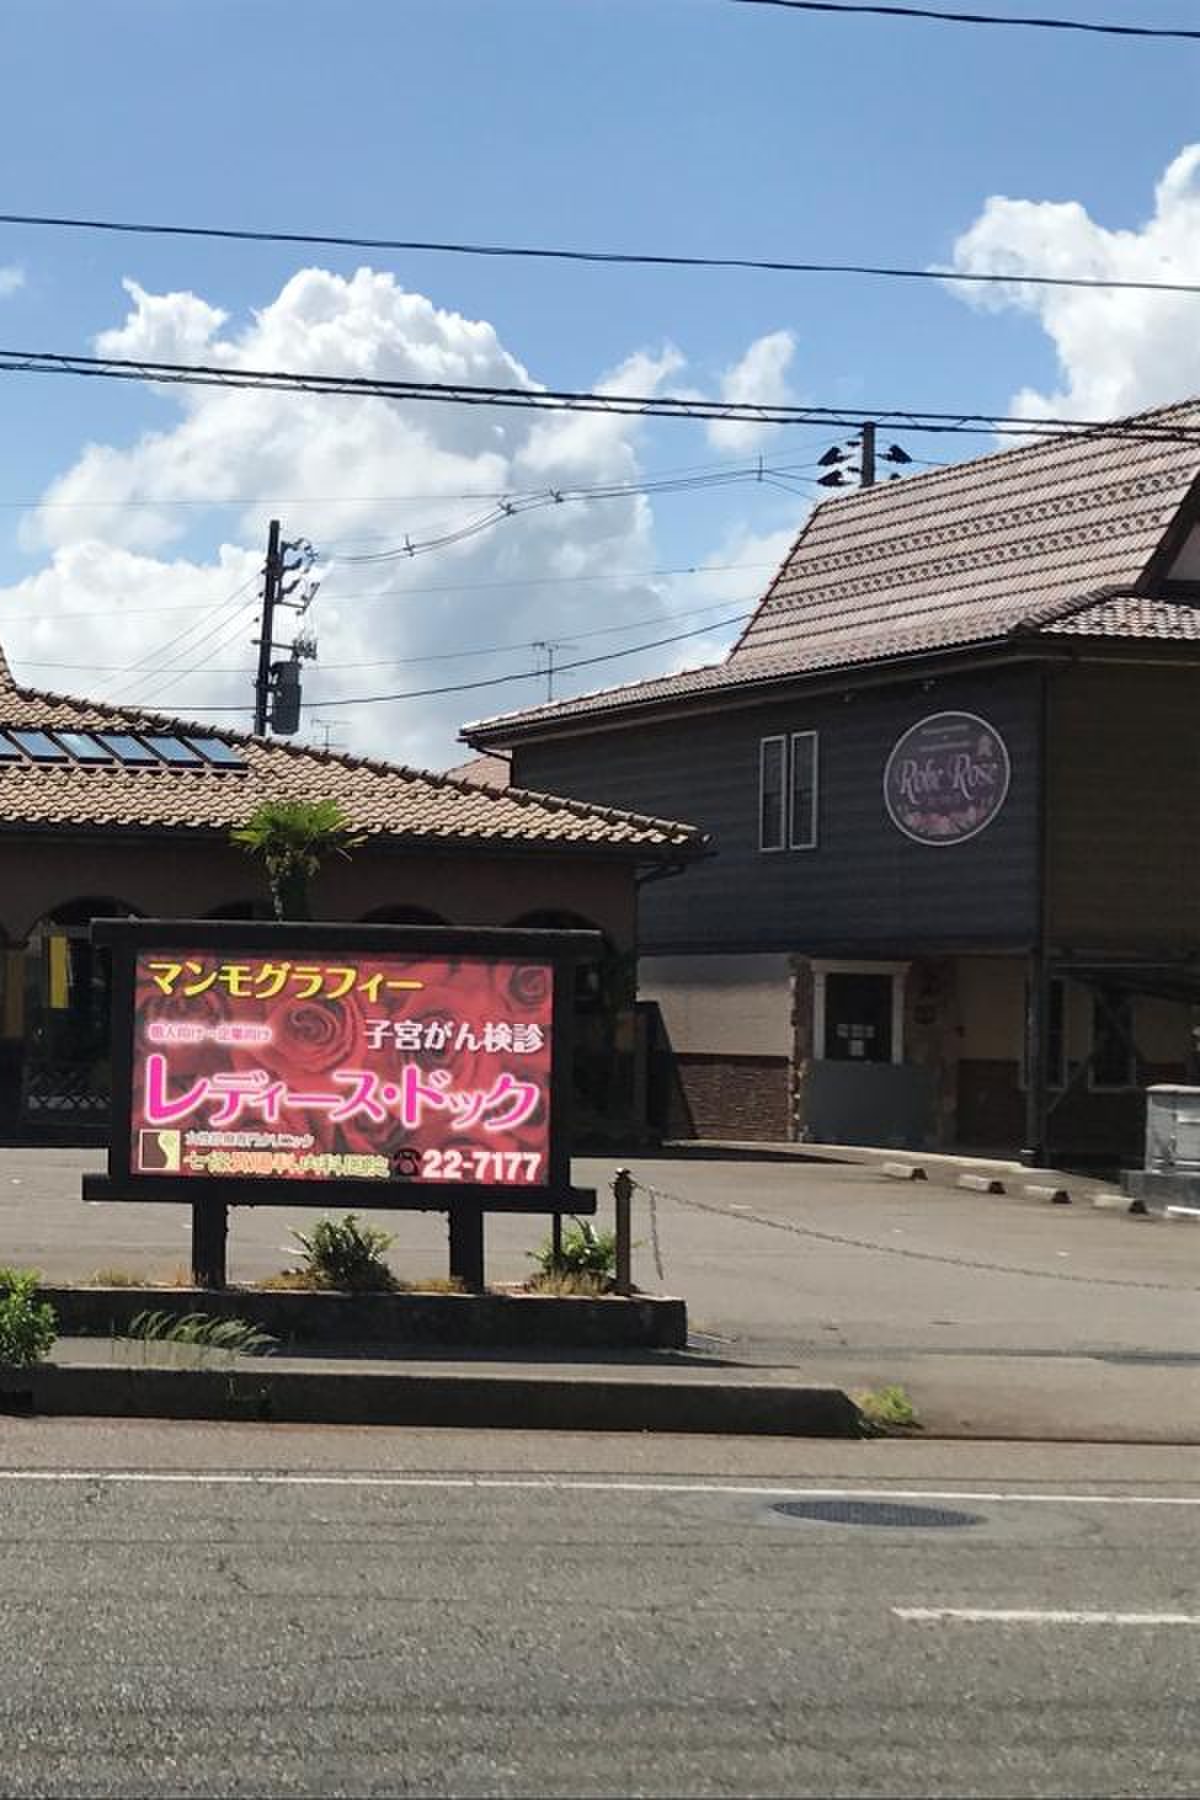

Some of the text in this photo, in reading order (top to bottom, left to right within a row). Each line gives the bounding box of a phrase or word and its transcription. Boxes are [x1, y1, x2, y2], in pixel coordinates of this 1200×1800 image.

[148, 962, 423, 1002] マンモグラフィー
[363, 1019, 545, 1053] 子宮がん検診
[146, 1054, 540, 1128] レディース・ドック
[422, 1149, 541, 1182] 22-7177
